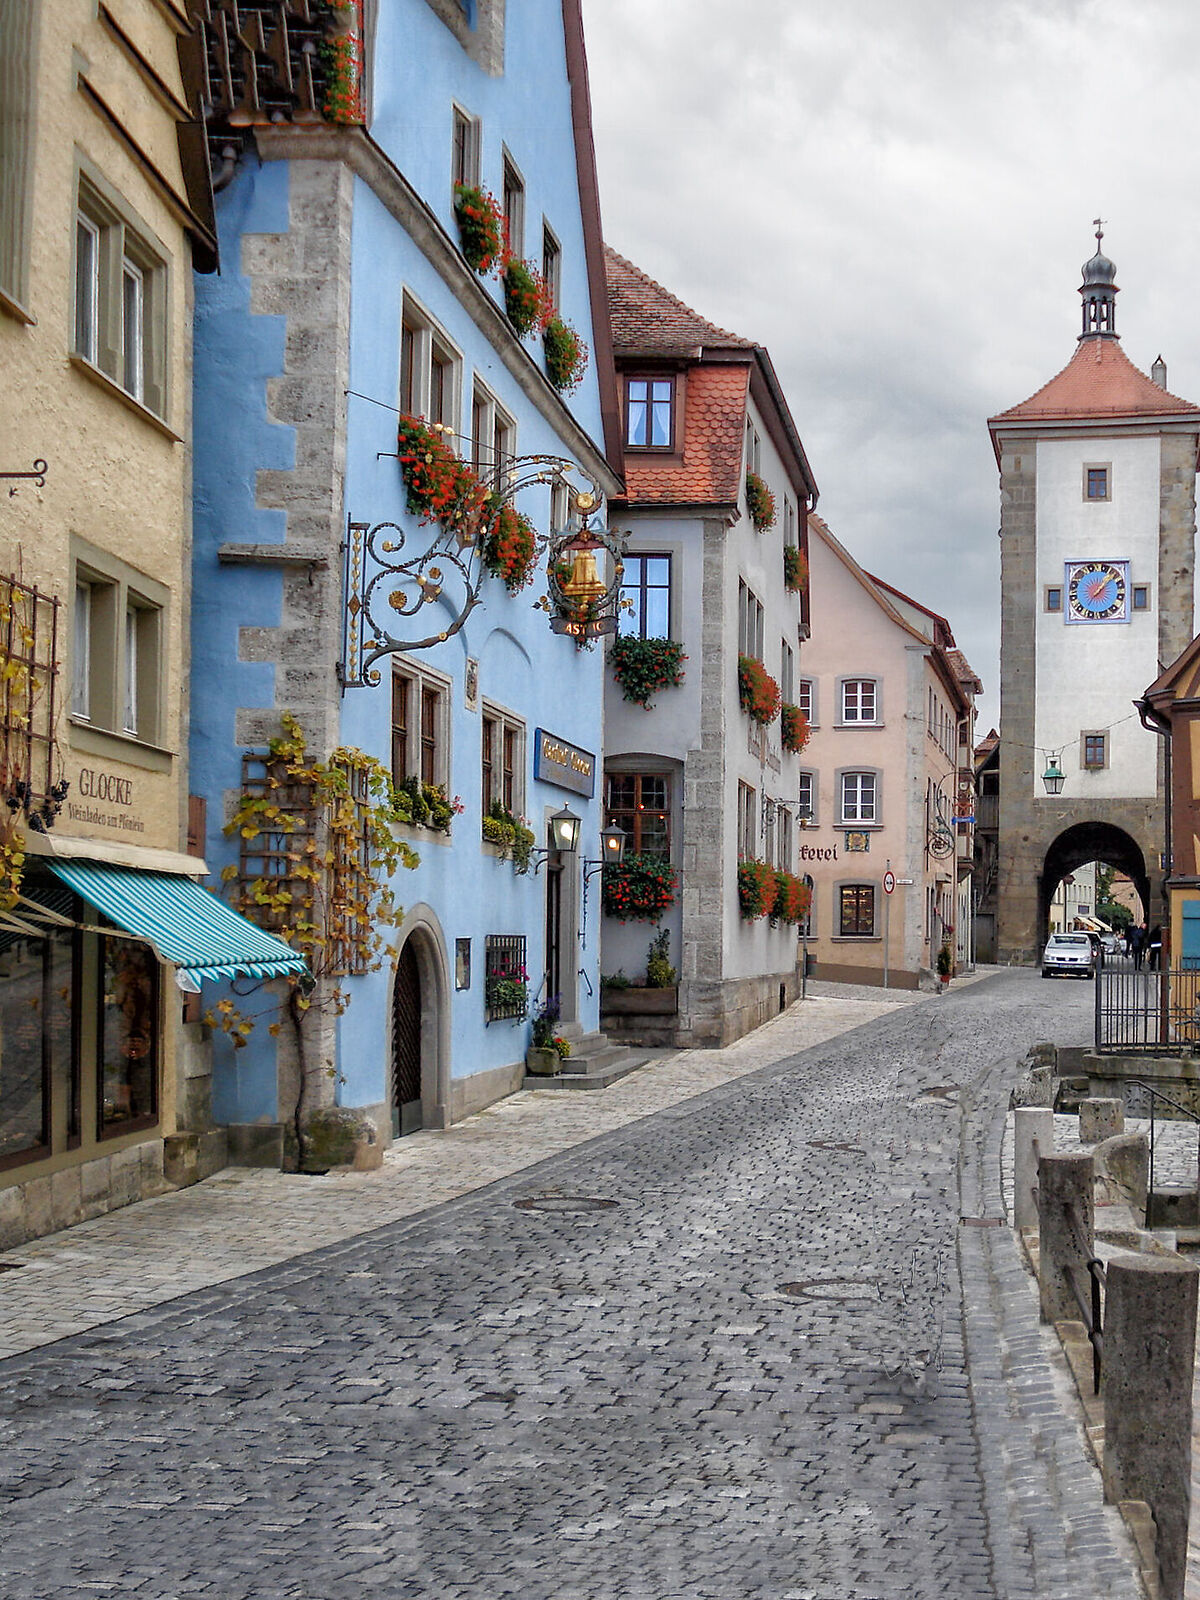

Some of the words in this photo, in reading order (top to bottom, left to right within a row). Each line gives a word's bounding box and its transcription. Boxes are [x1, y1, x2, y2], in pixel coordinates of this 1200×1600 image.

[80, 768, 133, 806] GLOCKE
[68, 803, 106, 826] Weinladen
[107, 815, 118, 828] am
[799, 843, 839, 861] kerei
